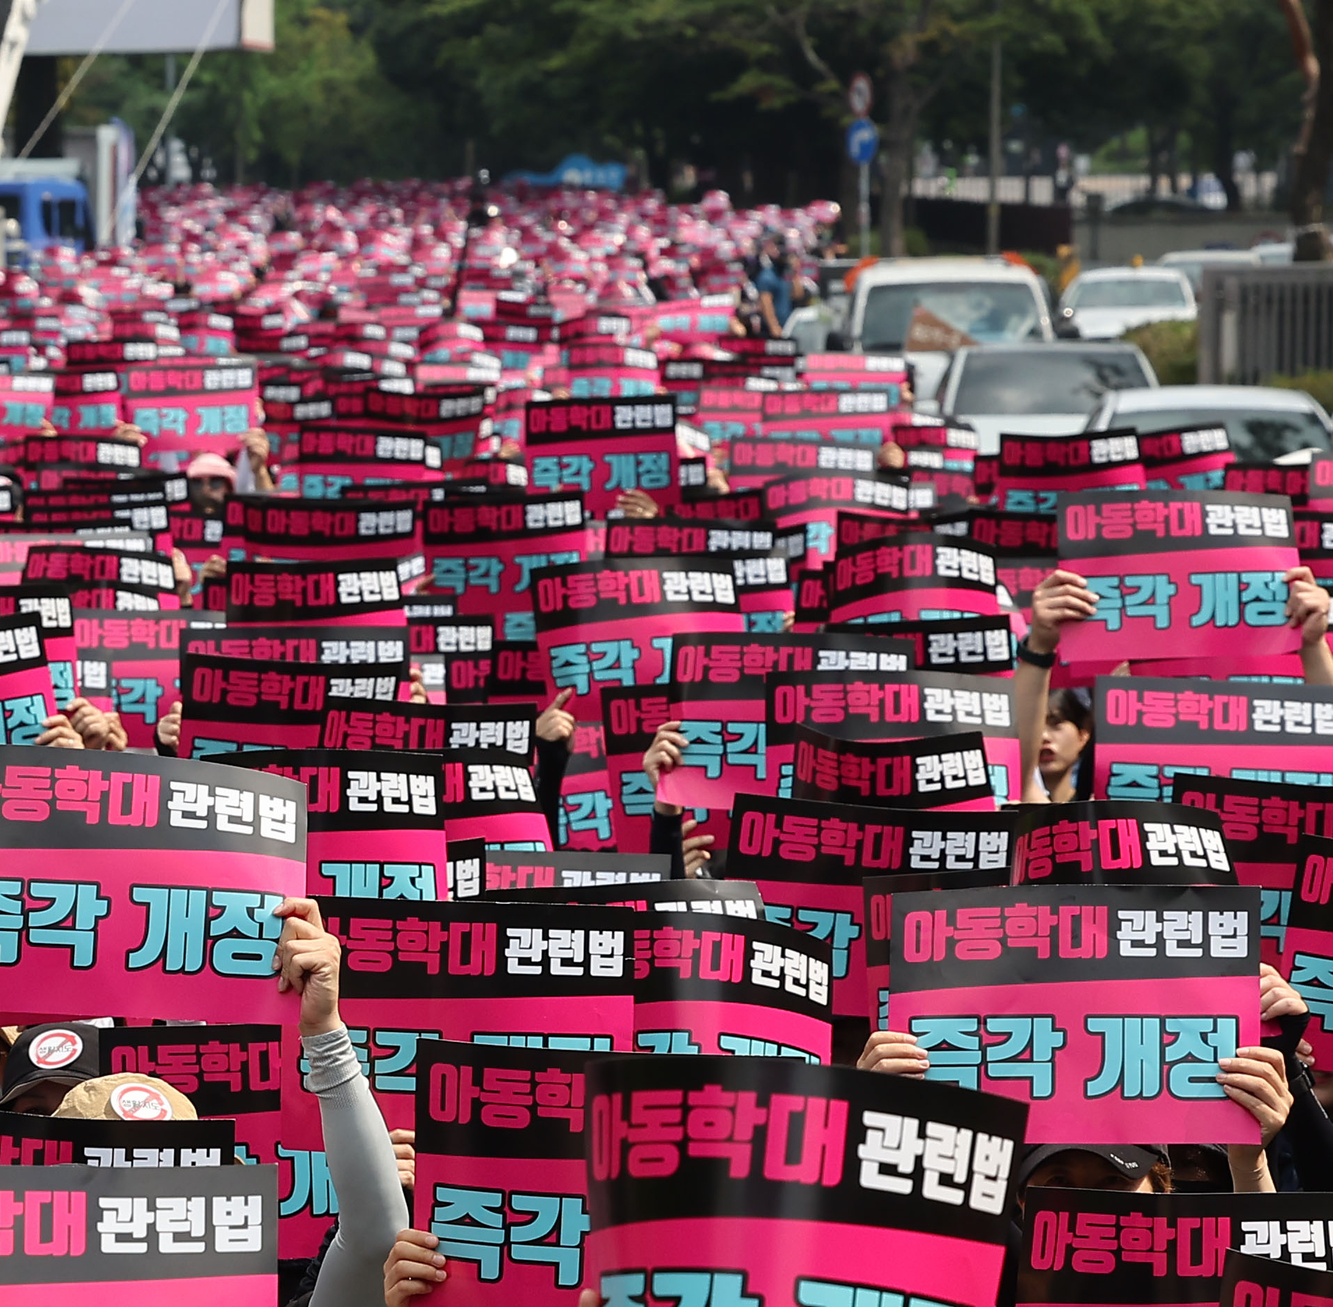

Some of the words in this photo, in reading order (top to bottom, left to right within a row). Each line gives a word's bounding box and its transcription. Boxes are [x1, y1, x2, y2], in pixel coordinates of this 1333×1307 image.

[533, 453, 595, 493] 즉각
[603, 452, 671, 491] 개정
[523, 499, 584, 529] 관련법
[1064, 500, 1203, 542] 아동학대
[1204, 504, 1291, 539] 관련법
[119, 555, 177, 591] 관련법
[230, 571, 336, 608] 아동학대
[336, 569, 401, 604] 관련법
[433, 556, 504, 596] 즉각
[536, 568, 662, 614] 아동학대
[661, 569, 737, 606] 관련법
[835, 541, 934, 593] 아동학대
[935, 546, 996, 588] 관련법
[1085, 574, 1177, 632] 즉각
[1189, 570, 1291, 628] 개정
[548, 637, 641, 697] 즉각
[675, 642, 814, 684] 아동학대
[927, 628, 1011, 666] 관련법
[191, 665, 326, 711] 아동학대
[773, 681, 921, 725] 아동학대
[922, 686, 1013, 729] 관련법
[1105, 687, 1248, 733] 아동학대
[323, 711, 445, 750] 아동학대
[345, 769, 437, 816] 관련법
[795, 747, 913, 798] 아동학대
[914, 748, 988, 795] 관련법
[165, 777, 297, 845] 관련법
[738, 810, 904, 870] 아동학대
[908, 829, 1010, 871] 관련법
[1141, 822, 1231, 873] 관련법
[126, 882, 286, 979] 개정
[504, 925, 625, 978] 관련법
[903, 902, 1109, 963] 아동학대
[1116, 908, 1250, 959] 관련법
[749, 940, 830, 1006] 관련법
[908, 1014, 1067, 1099] 즉각
[1084, 1014, 1242, 1100] 개정
[857, 1109, 1015, 1216] 관련법
[95, 1194, 263, 1255] 관련법
[429, 1184, 590, 1288] 즉각
[1030, 1211, 1232, 1277] 아동학대
